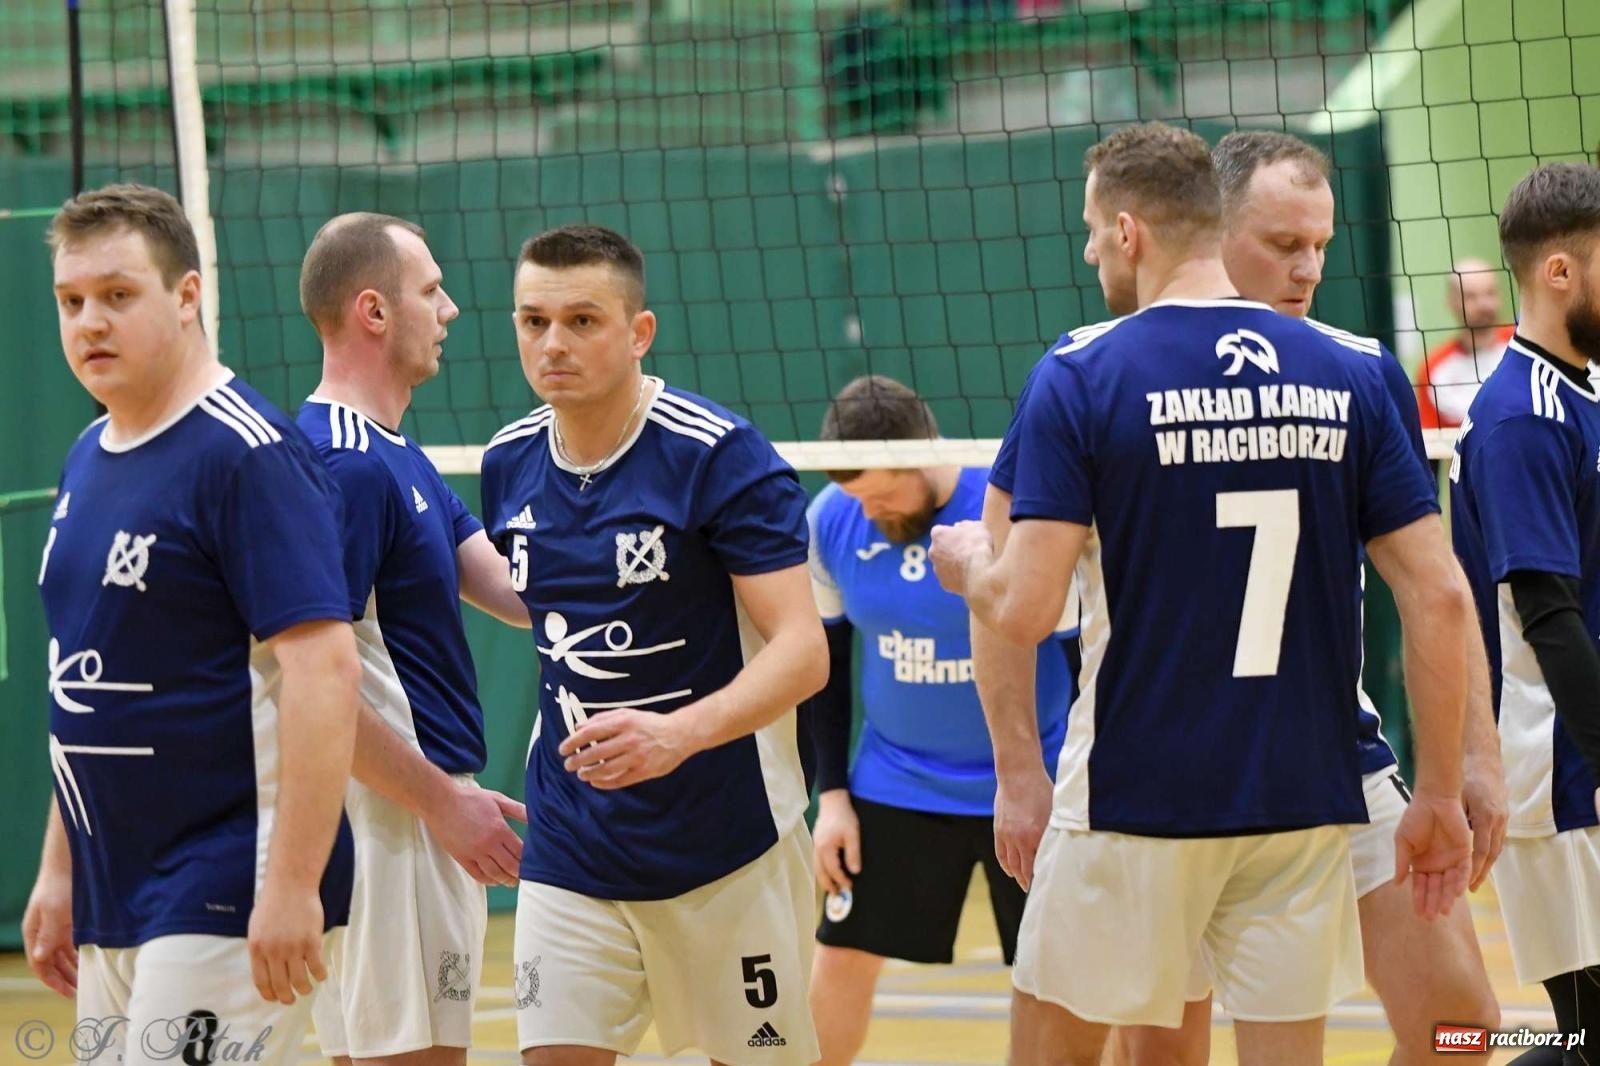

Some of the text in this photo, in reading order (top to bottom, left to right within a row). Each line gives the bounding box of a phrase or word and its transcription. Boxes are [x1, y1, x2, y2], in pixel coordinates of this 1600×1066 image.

[1146, 384, 1351, 425] ZAKŁAD KARNY
[1155, 424, 1348, 466] W RACIBORZU
[512, 534, 529, 593] 5
[900, 544, 927, 582] 8
[1216, 489, 1300, 678] 7
[741, 954, 778, 1008] 5
[182, 1009, 220, 1066] 8
[747, 1036, 787, 1047] adidas
